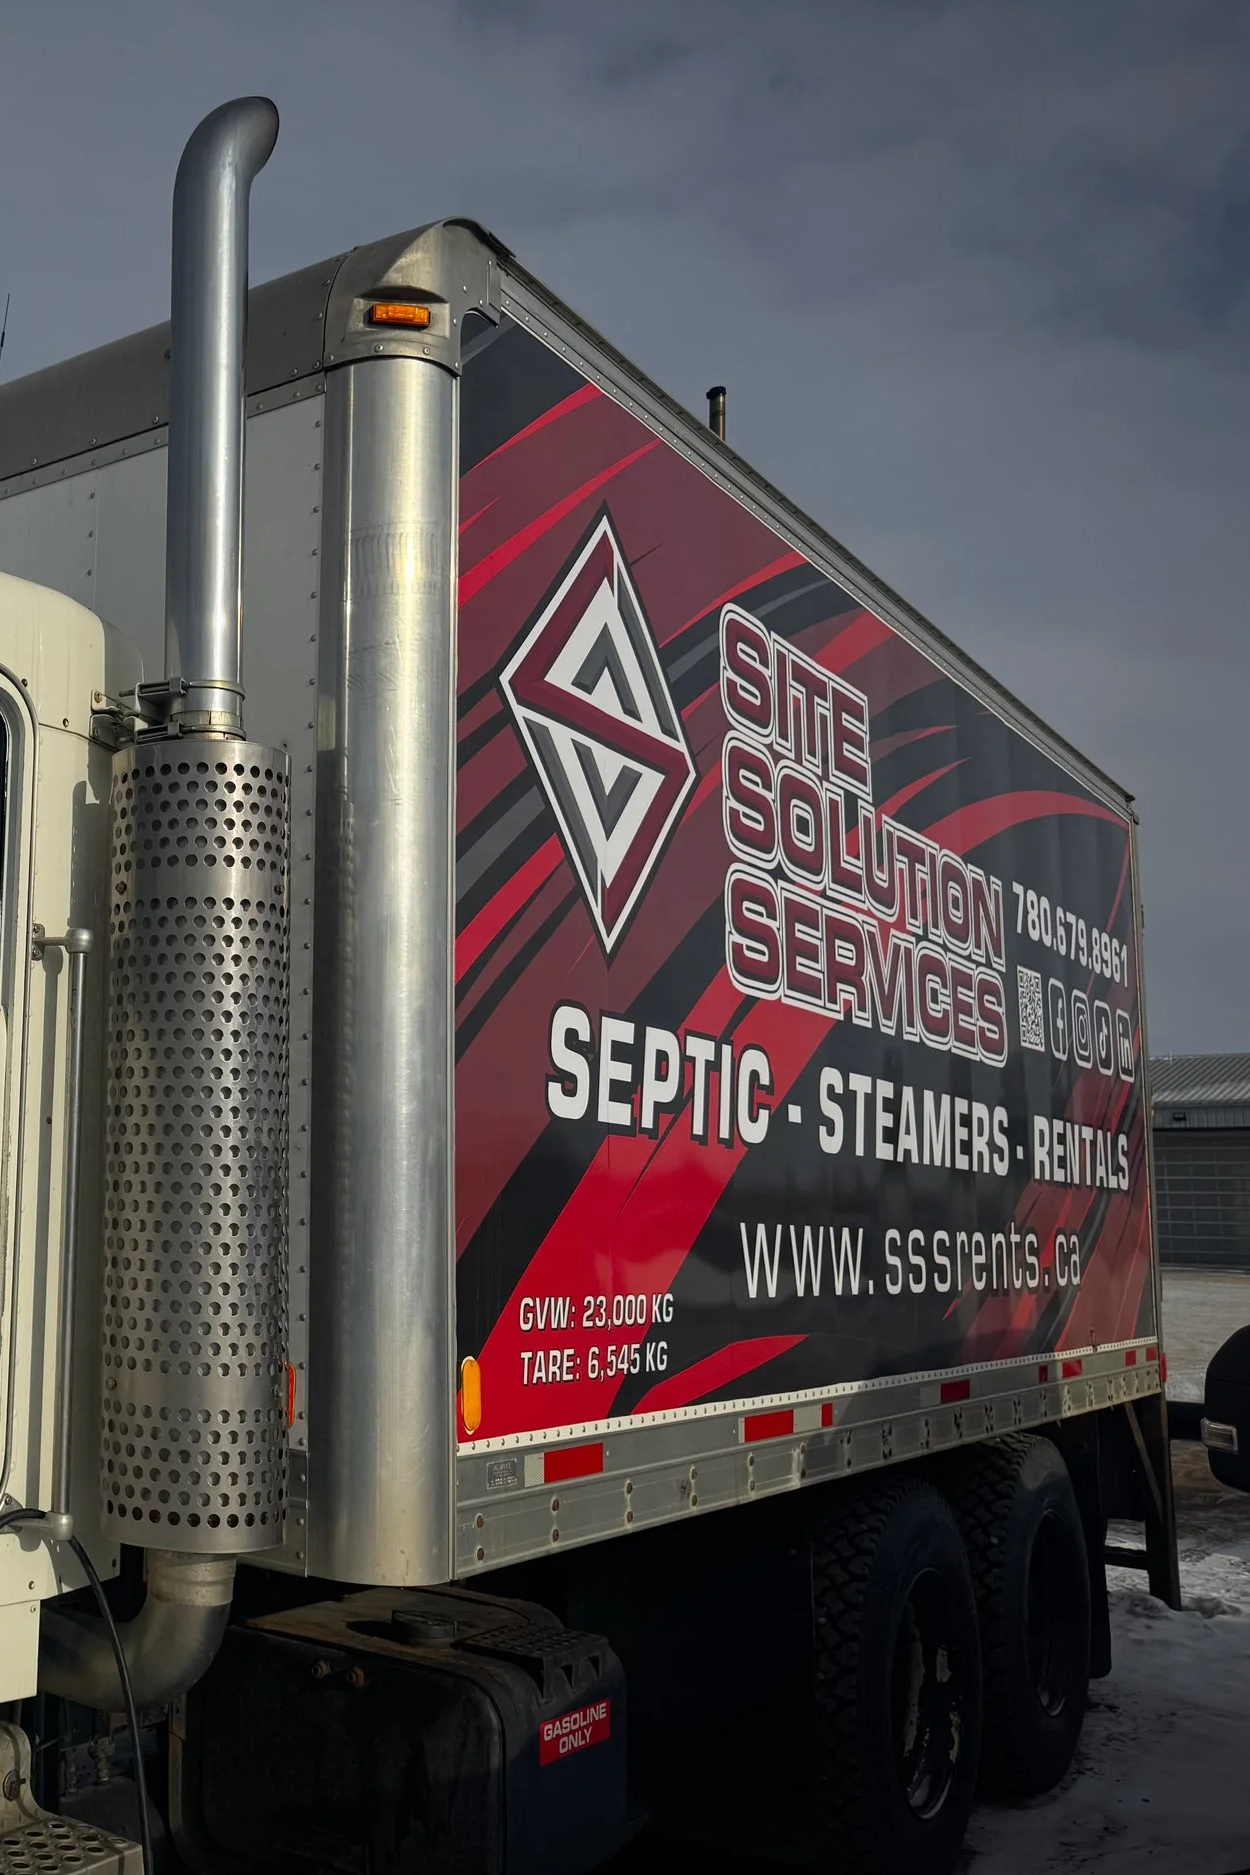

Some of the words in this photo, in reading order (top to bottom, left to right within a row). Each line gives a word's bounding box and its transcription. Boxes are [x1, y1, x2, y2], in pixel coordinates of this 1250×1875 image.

[718, 602, 872, 803] SITE
[721, 730, 1006, 972] SOLUTION
[724, 862, 1008, 1068] SERVICES
[1012, 880, 1129, 988] 780.679.8961
[547, 1005, 772, 1144] SEPTIC
[818, 1066, 1009, 1177] STEAMERS
[1033, 1115, 1130, 1191] RENTALS
[519, 1297, 576, 1331] GVW:
[582, 1294, 647, 1331] 23,000
[651, 1293, 674, 1323] KG
[520, 1349, 581, 1385] TARE:
[587, 1343, 640, 1382] 6,545
[645, 1341, 668, 1372] KG
[543, 1702, 607, 1741] GASOLINE
[559, 1726, 592, 1754] ONLY
